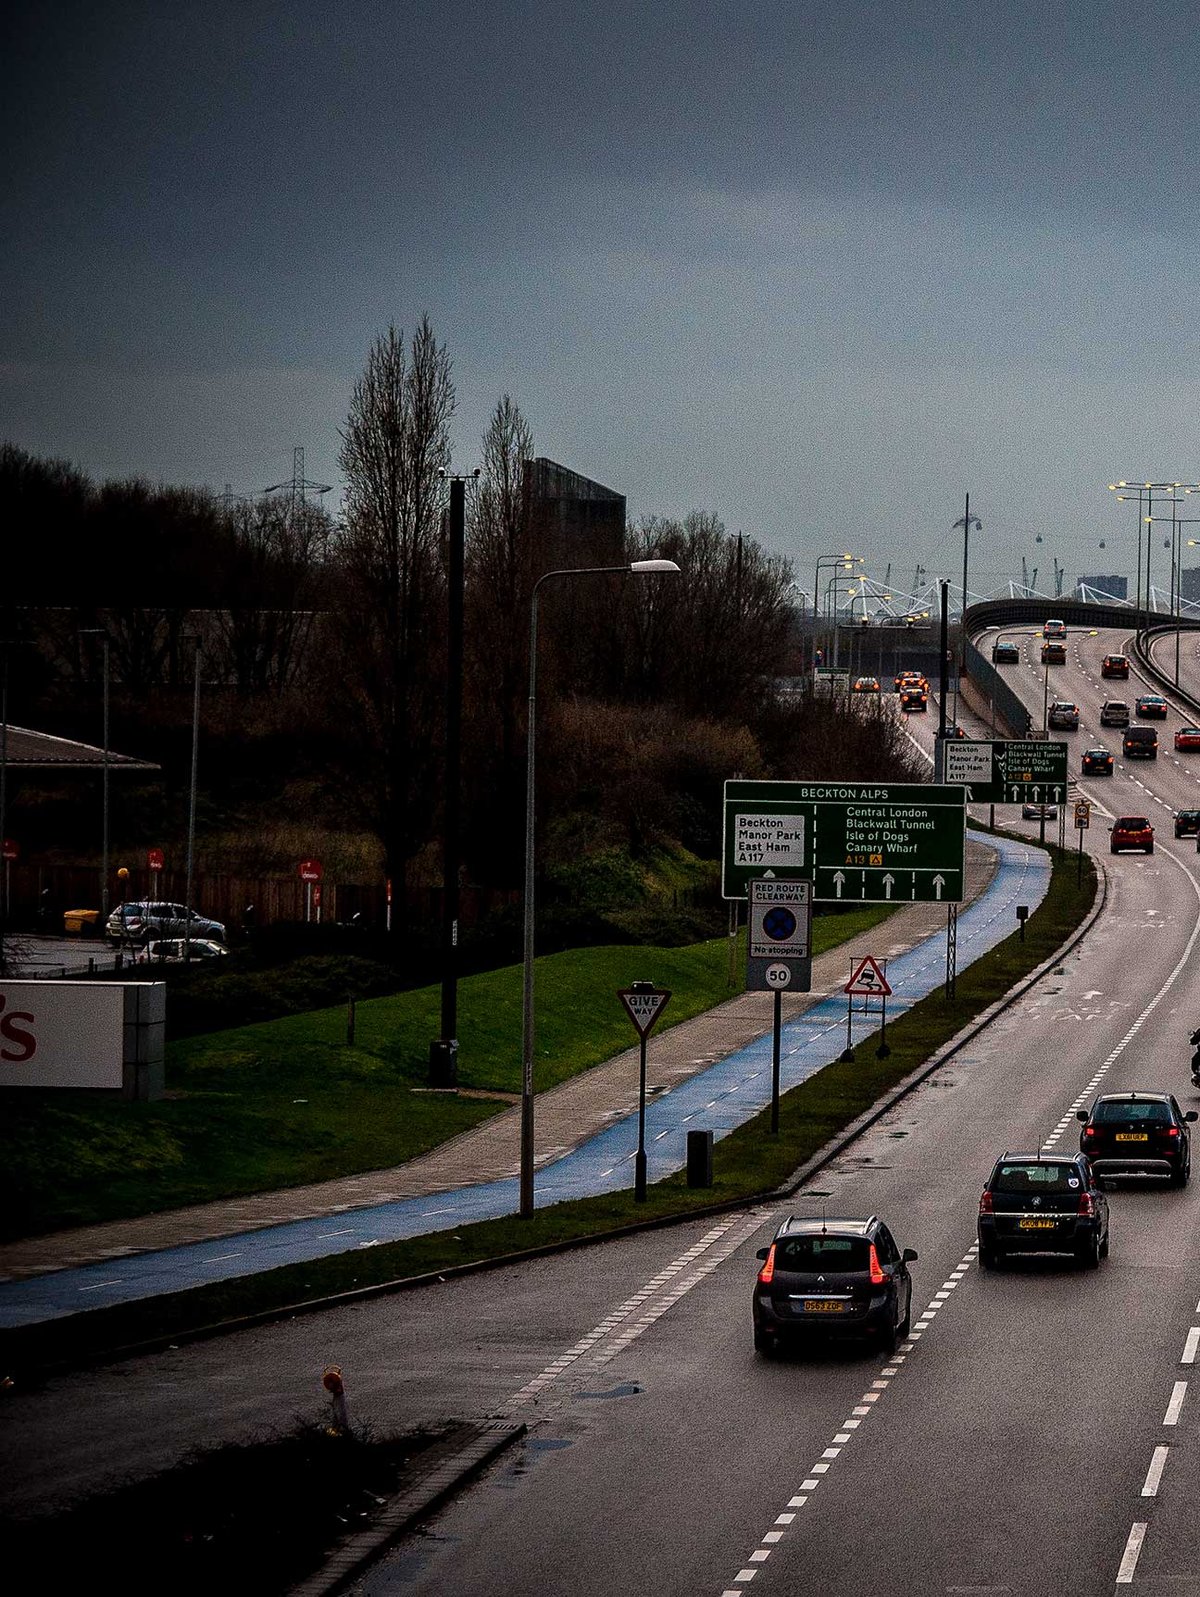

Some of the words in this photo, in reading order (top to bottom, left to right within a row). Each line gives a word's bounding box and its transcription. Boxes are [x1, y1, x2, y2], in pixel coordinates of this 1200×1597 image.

[801, 788, 856, 798] BECKTON
[860, 789, 889, 799] ALPS
[846, 807, 886, 817] Central
[889, 808, 928, 818] London
[739, 818, 783, 828] Beckton
[846, 819, 897, 829] Blackwall
[900, 820, 935, 830] Tunnel
[739, 830, 774, 839] Manor
[777, 831, 801, 840] Park
[846, 831, 866, 840] Isle
[868, 831, 880, 840] of
[883, 832, 909, 843] Dogs
[739, 842, 762, 851] East
[766, 843, 790, 852] Ham
[846, 843, 883, 854] Canary
[886, 843, 918, 853] Wharf
[739, 853, 763, 862] A117
[845, 855, 865, 865] A13
[755, 884, 774, 892] RED
[775, 884, 805, 893] ROUTE
[755, 892, 805, 901] CLEARWAY
[754, 946, 766, 954] No
[768, 946, 803, 956] stopping
[770, 970, 786, 980] 50
[629, 996, 659, 1006] GIVE
[634, 1006, 653, 1016] WAY
